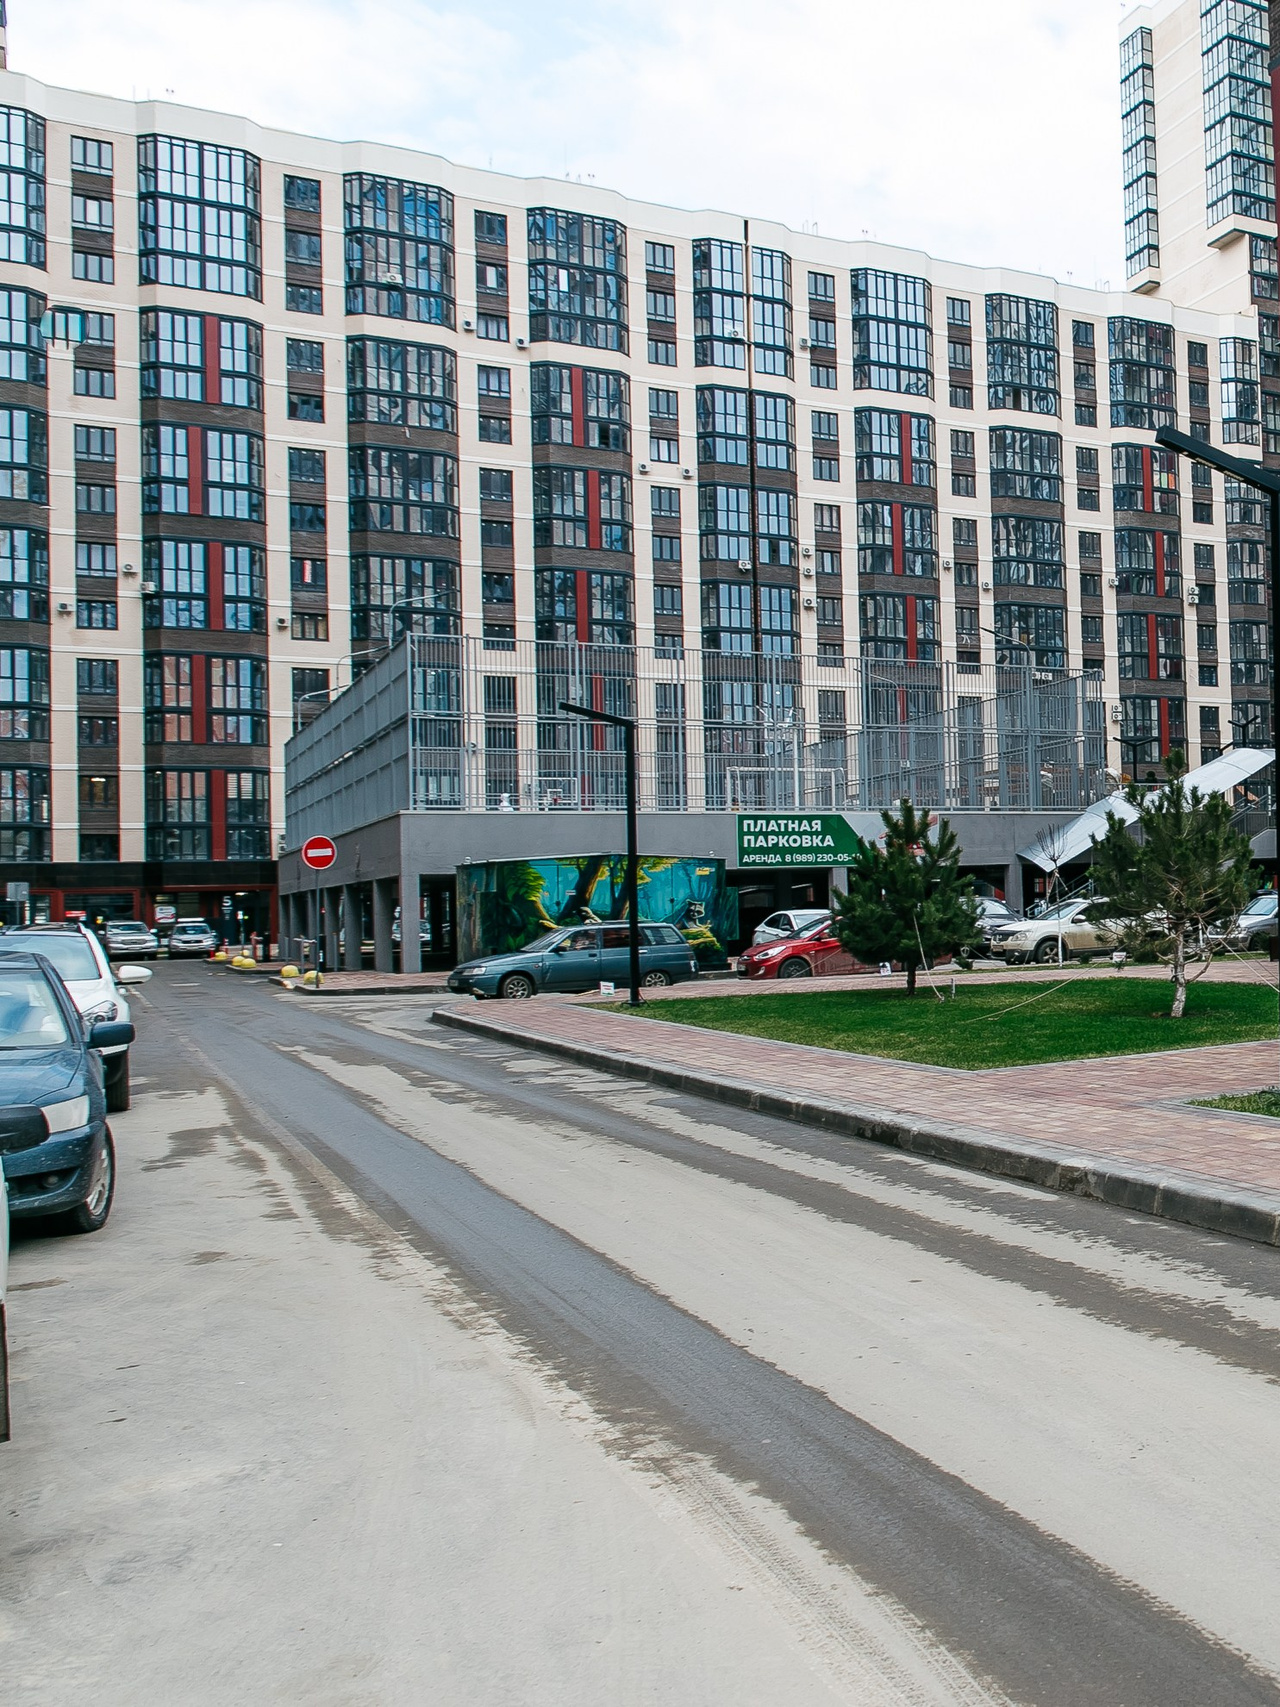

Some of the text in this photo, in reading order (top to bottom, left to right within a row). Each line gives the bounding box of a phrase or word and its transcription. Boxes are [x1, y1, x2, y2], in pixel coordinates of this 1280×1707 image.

[743, 819, 822, 832] ПЛАТНАЯ
[743, 835, 835, 847] ПАРКОВКА
[742, 854, 782, 863] АРЕНДА
[784, 854, 792, 862] 8
[792, 853, 816, 863] (989)
[222, 895, 232, 906] 5
